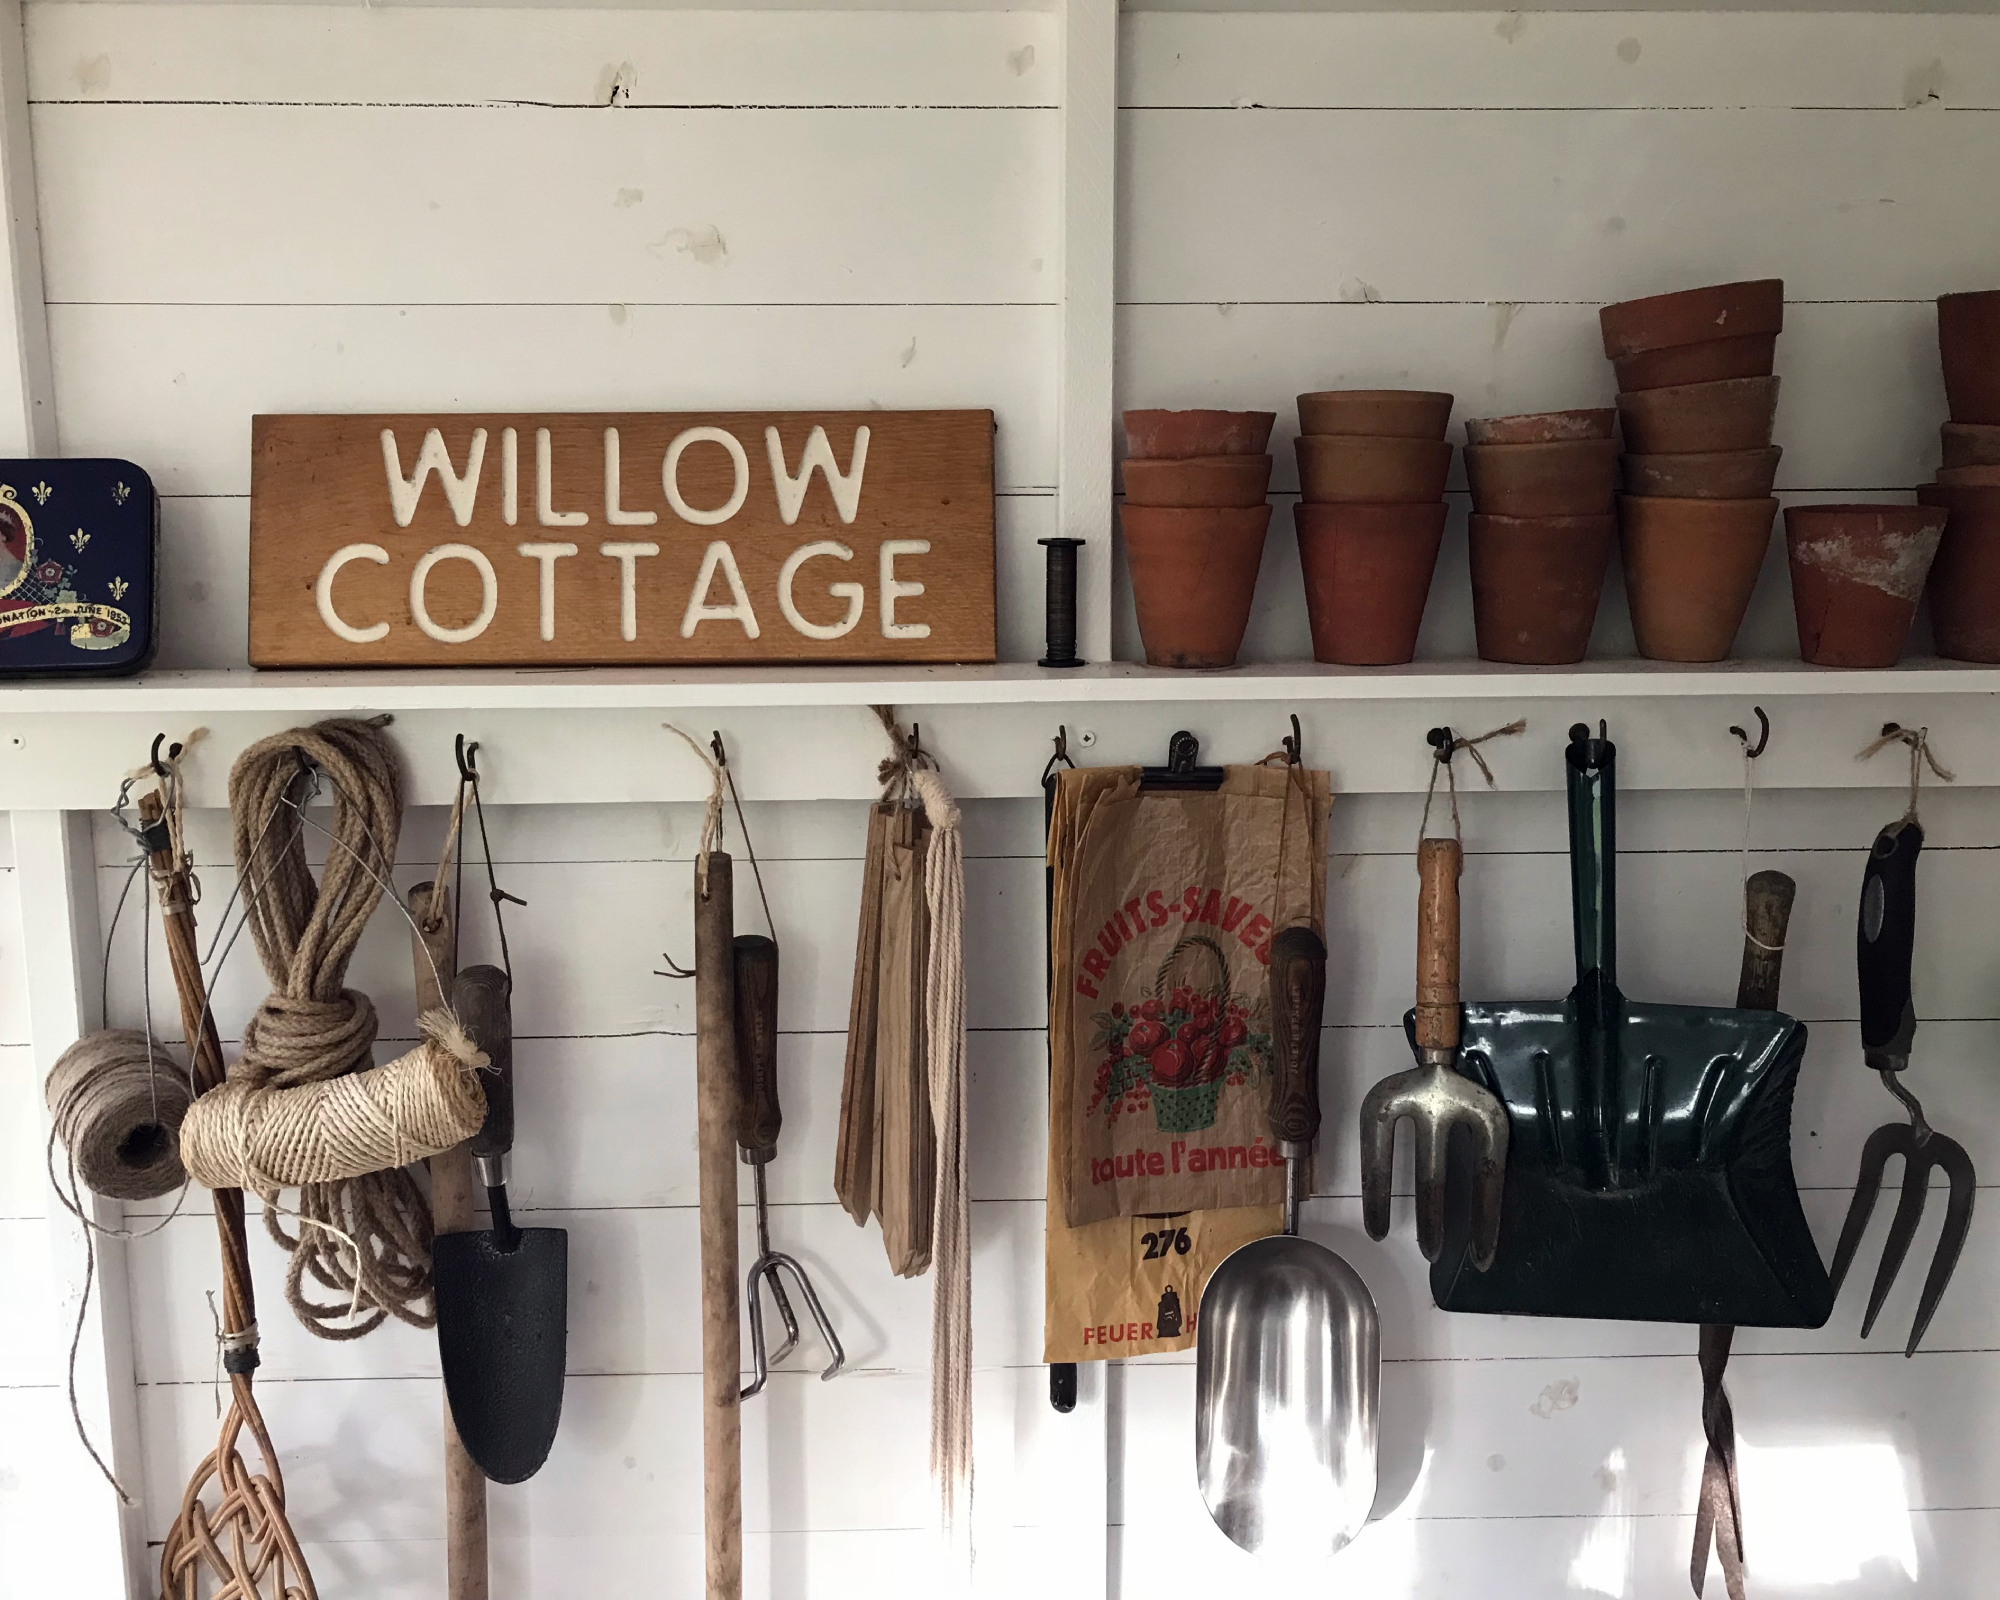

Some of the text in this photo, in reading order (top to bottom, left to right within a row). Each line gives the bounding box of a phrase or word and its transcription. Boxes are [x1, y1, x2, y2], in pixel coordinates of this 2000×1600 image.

[380, 425, 871, 527] WILLOW
[316, 539, 931, 643] COTTAGE
[73, 605, 102, 615] JUNE
[107, 609, 129, 625] 1953
[1090, 1148, 1165, 1185] toute
[1140, 1227, 1192, 1260] 276
[1083, 1322, 1154, 1345] FEUER
